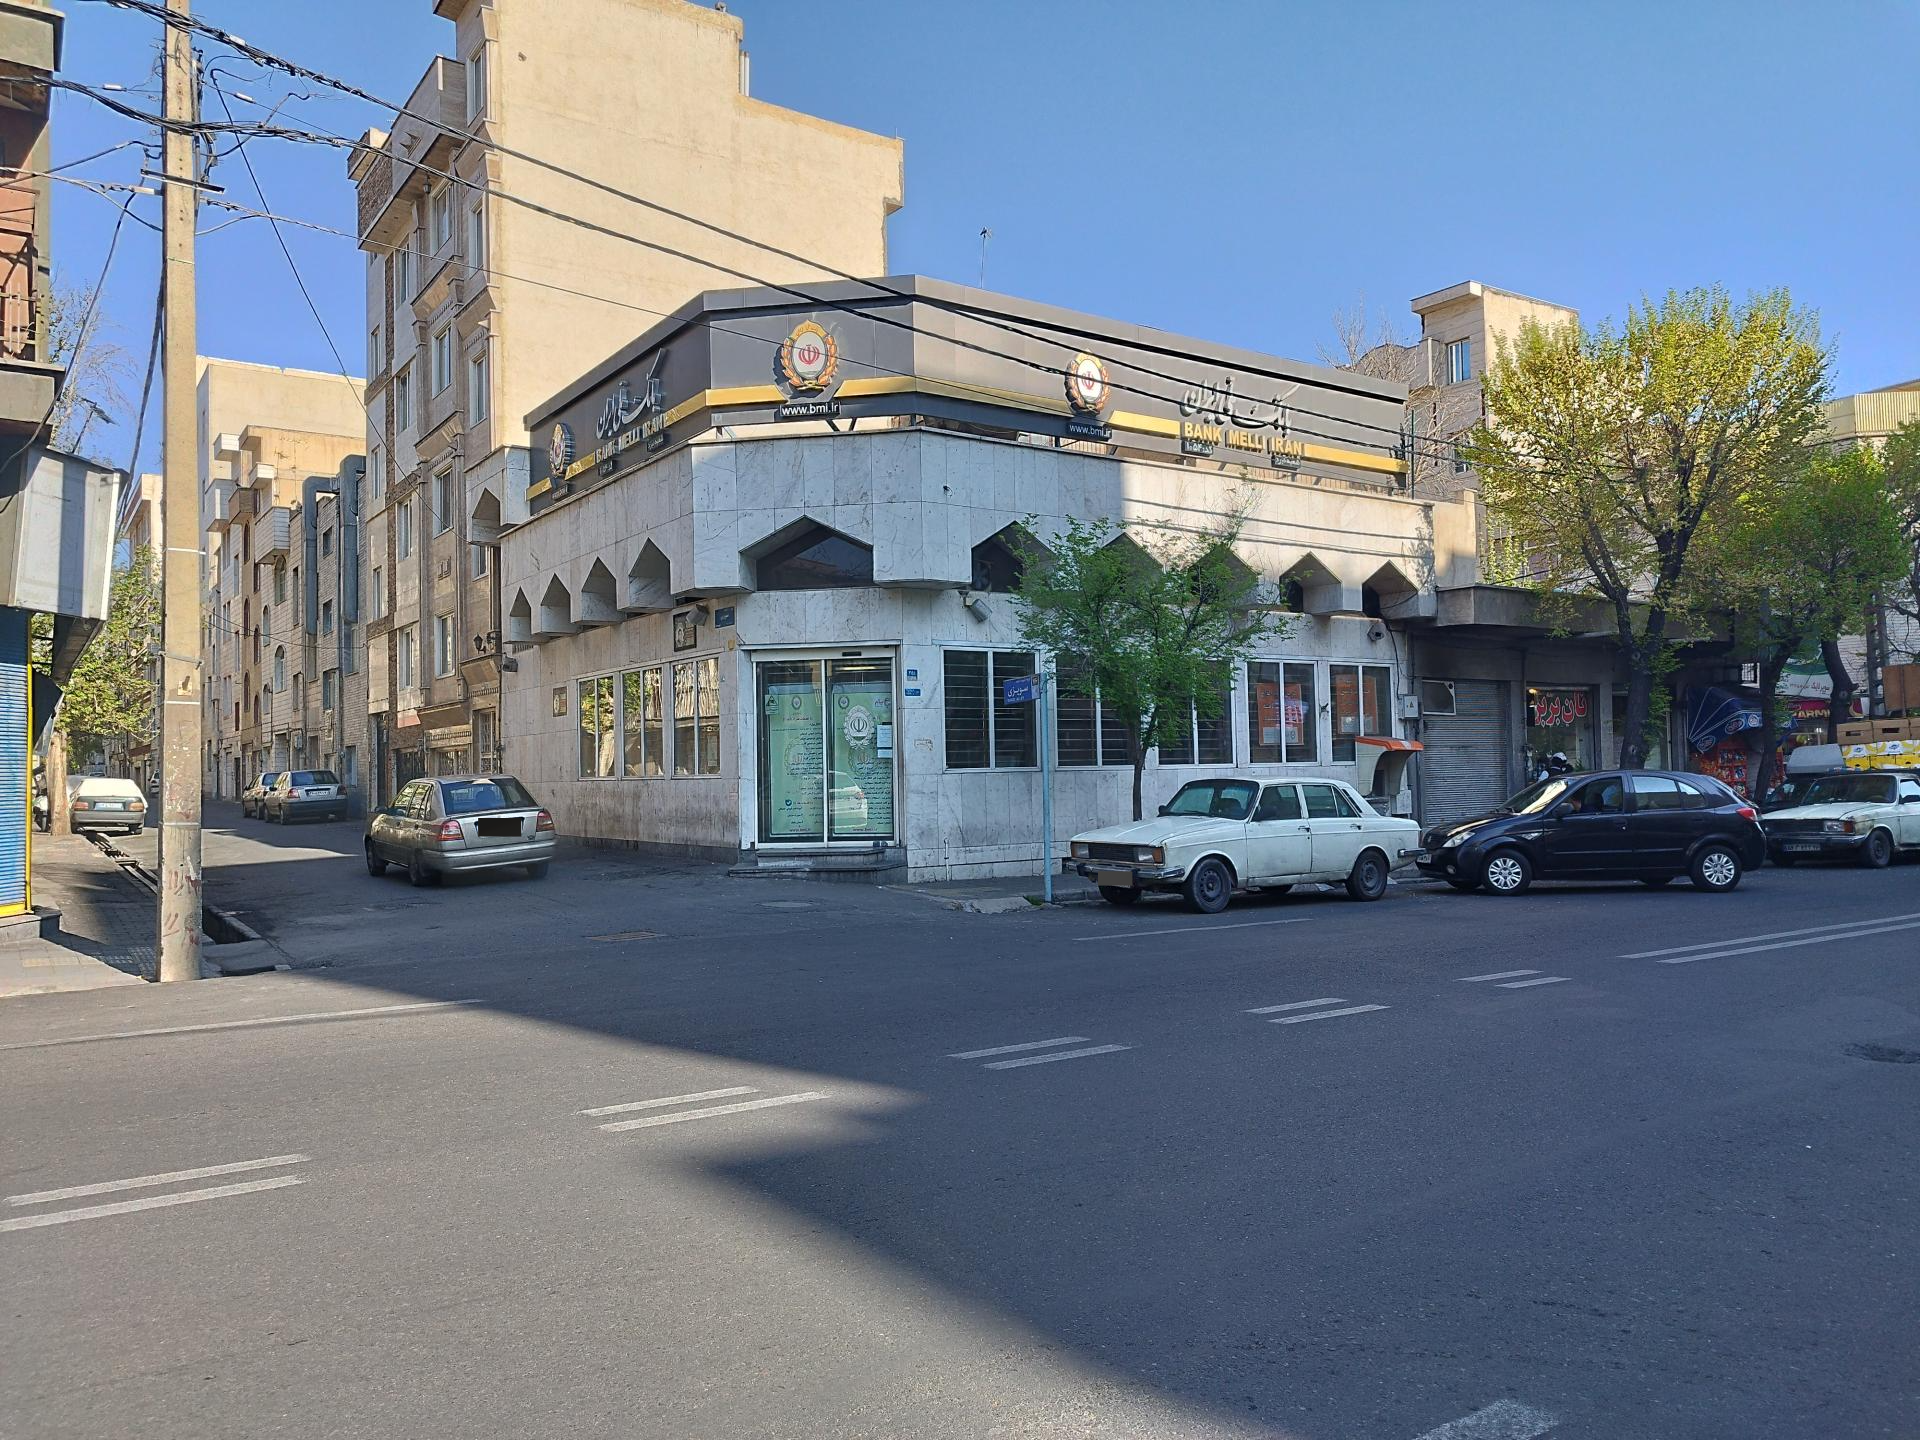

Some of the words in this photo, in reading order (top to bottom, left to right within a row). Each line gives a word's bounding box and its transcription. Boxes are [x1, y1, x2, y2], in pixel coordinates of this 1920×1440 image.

[780, 402, 840, 415] www.bmi.ir
[595, 441, 616, 463] BANK
[618, 426, 641, 451] MELLI
[642, 413, 663, 439] IRAN
[1069, 424, 1111, 437] www.bmi.ir
[1184, 421, 1222, 442] BANK
[1228, 429, 1266, 450] MELLI
[1271, 437, 1303, 457] IRAN
[1562, 692, 1588, 727] نان
